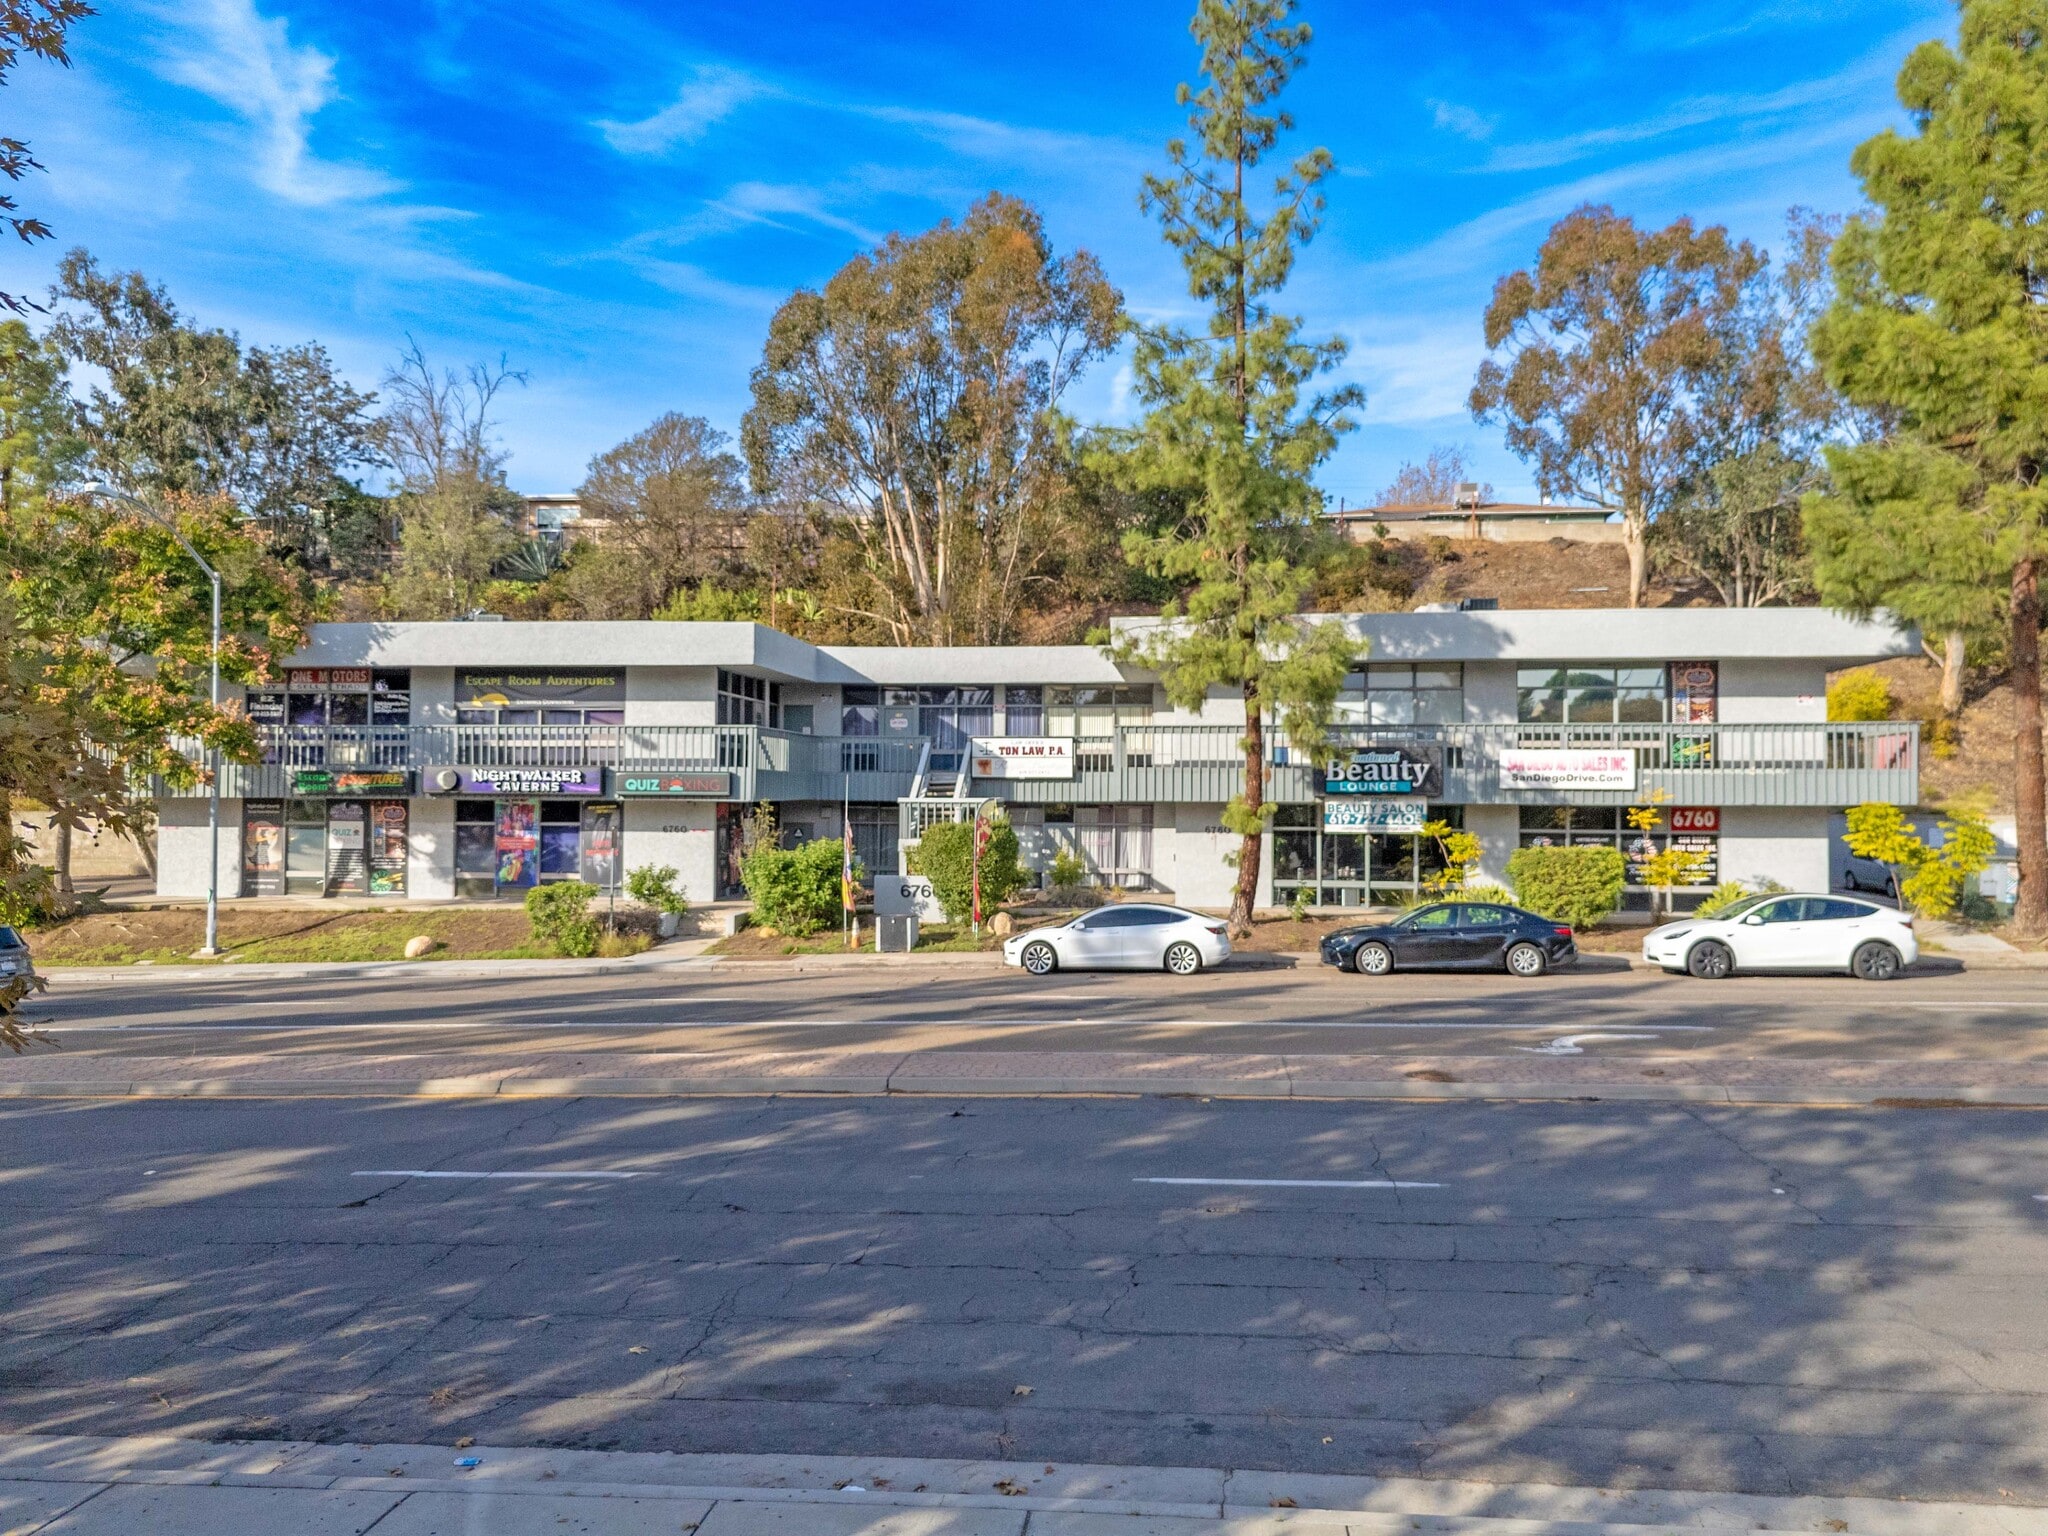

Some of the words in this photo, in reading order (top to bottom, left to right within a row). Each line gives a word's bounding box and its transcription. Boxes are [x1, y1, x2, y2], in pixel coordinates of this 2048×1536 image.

[291, 670, 313, 682] ONE
[998, 746, 1019, 755] TON
[1049, 746, 1066, 755] P.A.
[1326, 758, 1430, 787] Beauty
[494, 782, 561, 792] CAVERNS
[1339, 782, 1397, 791] LOUNGE
[1328, 804, 1377, 813] BEAUTY
[1381, 804, 1424, 813] SALON
[1673, 811, 1716, 827] 6760
[663, 825, 688, 833] 6760
